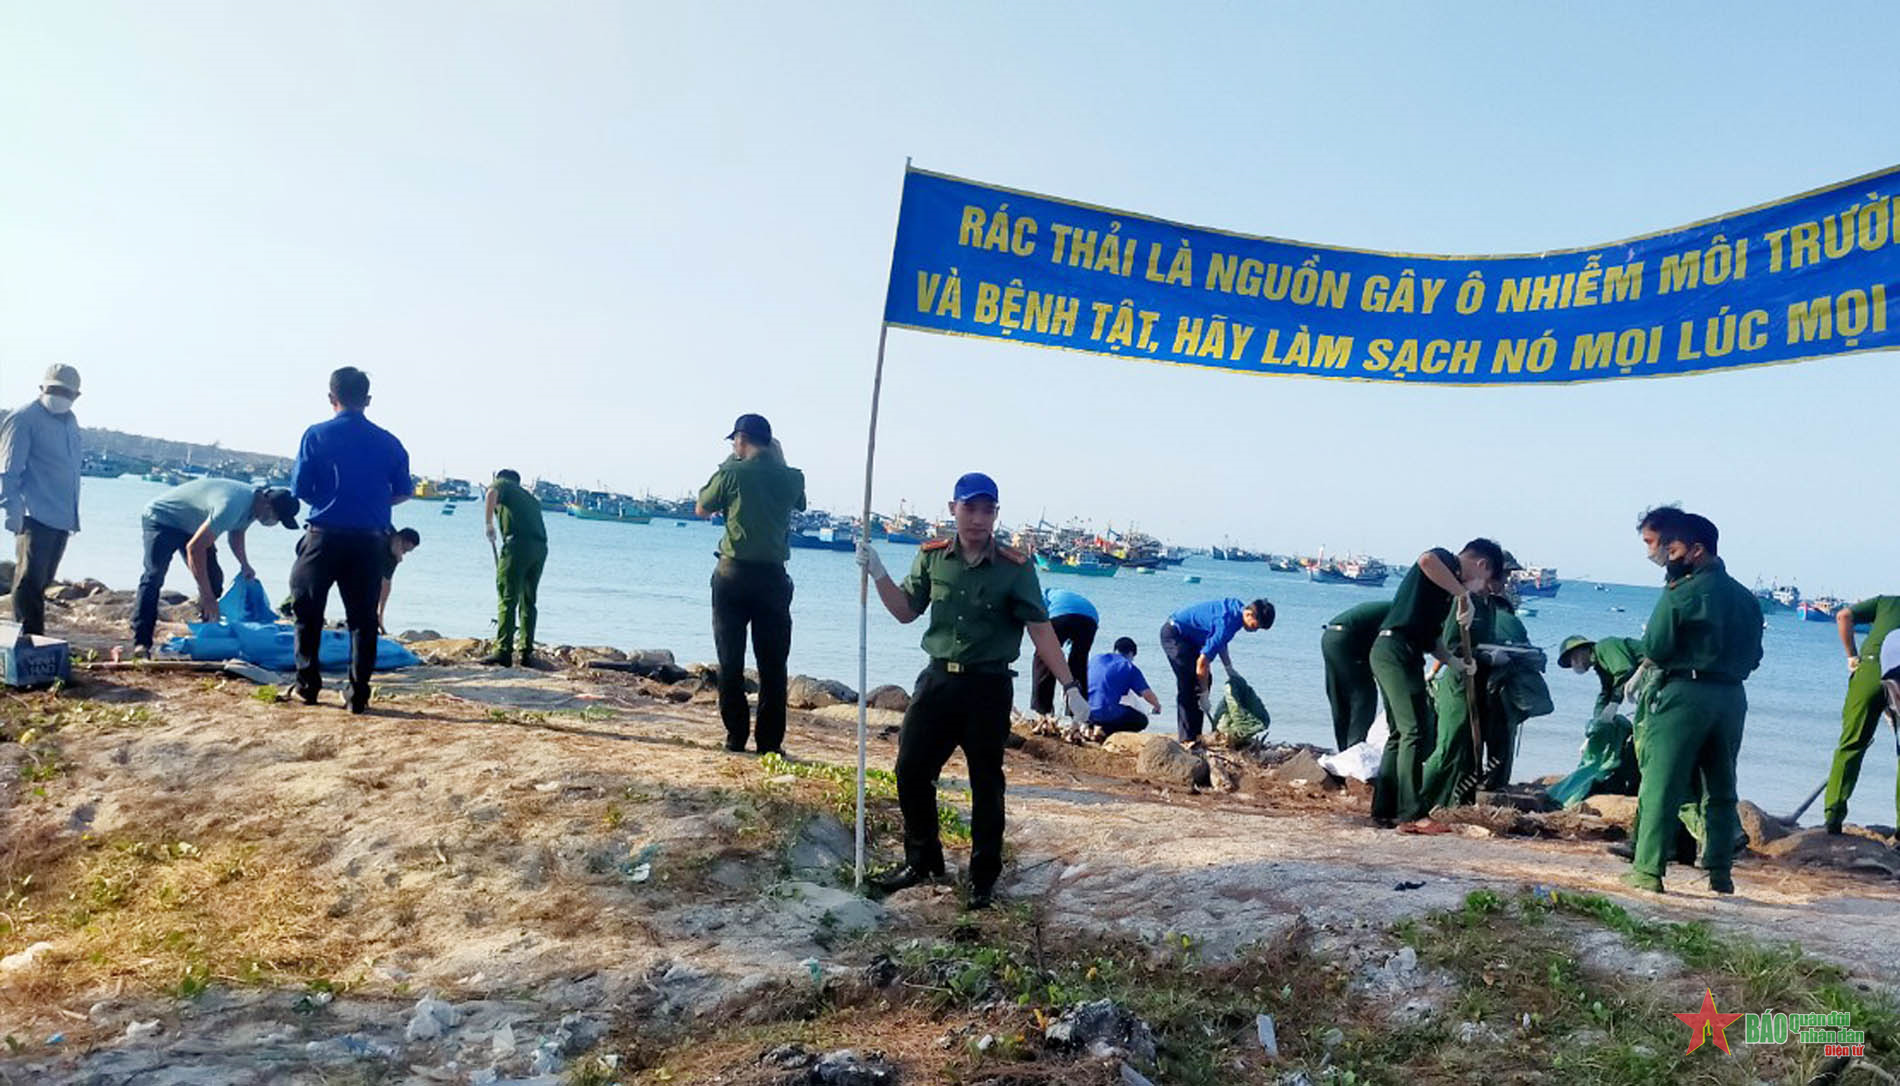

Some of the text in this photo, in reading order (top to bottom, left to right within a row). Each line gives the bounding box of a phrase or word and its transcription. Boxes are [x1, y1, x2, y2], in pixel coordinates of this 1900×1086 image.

[959, 191, 1900, 314] RÁC THẢI LÀ NGUỒN GÂY Ô NHIỄM MÔI TRƯỜ
[916, 266, 1887, 378] VÀ BỆNH TẬT, HÃY LÀM SẠCH NÓ MỌI LÚC MỌI
